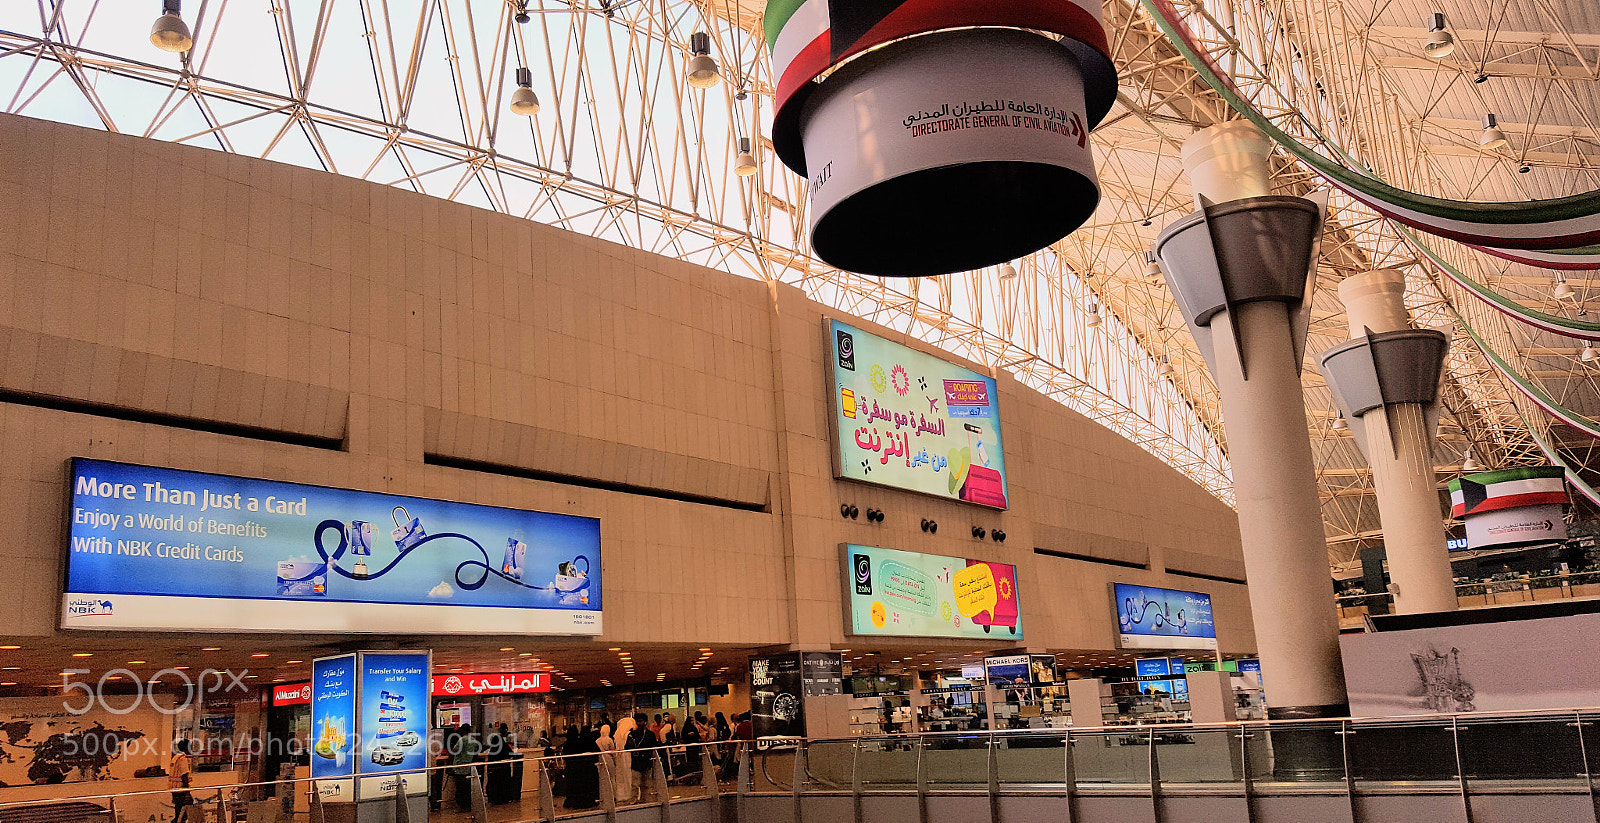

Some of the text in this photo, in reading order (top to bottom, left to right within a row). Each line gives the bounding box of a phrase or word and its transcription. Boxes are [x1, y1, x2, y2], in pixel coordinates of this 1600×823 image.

[902, 99, 1068, 129] الإدارة العامة للطيران المدني
[912, 115, 1071, 138] DIRECTORATE GENERAL OF CIVIL AVIATION
[861, 396, 945, 437] السفرة مو سفرة
[854, 426, 911, 467] إنترنت
[911, 446, 929, 468] غير
[931, 453, 948, 472] من
[76, 475, 307, 516] More Than Just a Card
[75, 507, 268, 538] Enjoy a World of Benefits
[73, 536, 244, 562] With NBK Credit Cards
[69, 606, 96, 614] NBK
[405, 667, 422, 675] Salary
[752, 659, 770, 667] MAKE
[469, 674, 540, 693] المزيني
[752, 677, 774, 686] COUNT
[753, 671, 767, 679] TIME
